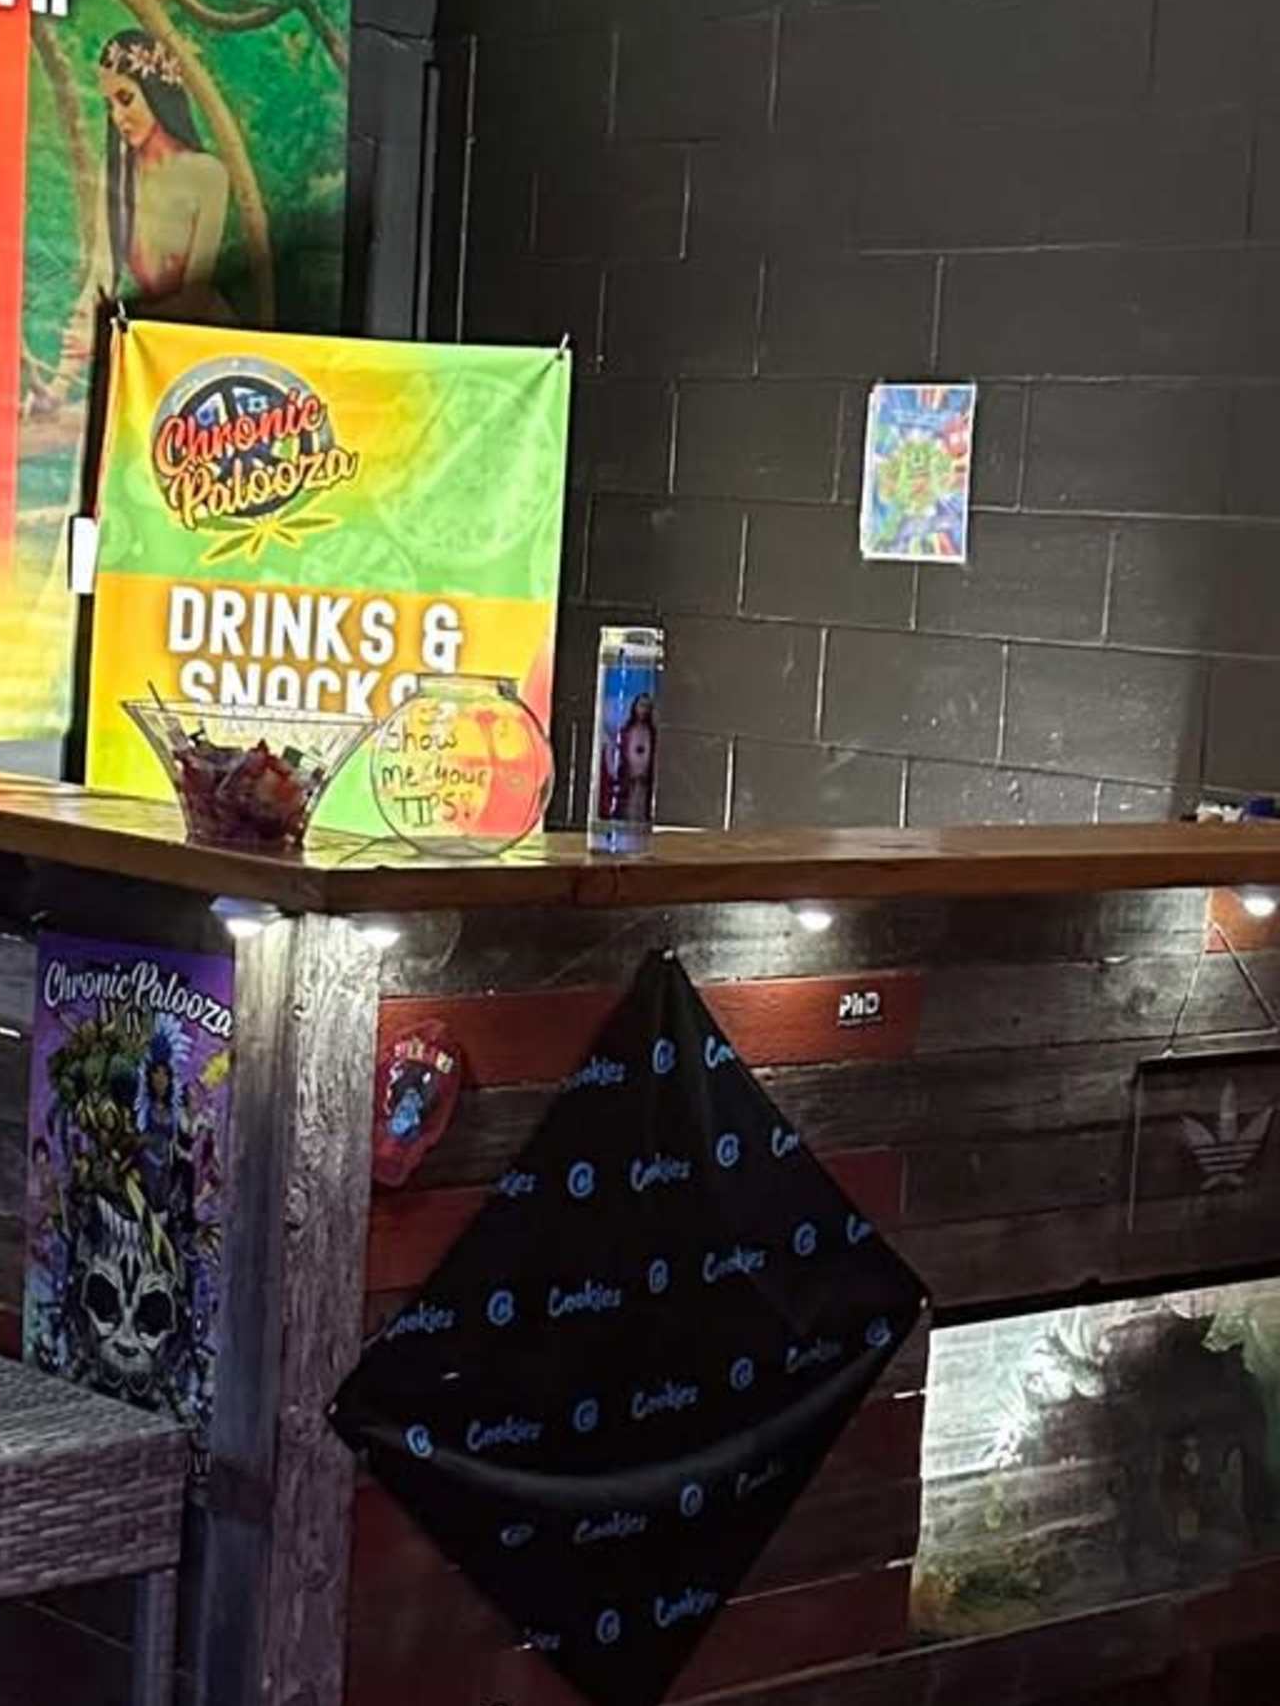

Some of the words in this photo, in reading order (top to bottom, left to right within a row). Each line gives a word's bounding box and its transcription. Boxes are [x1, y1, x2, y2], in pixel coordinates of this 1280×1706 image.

[153, 387, 327, 477] Chronic
[169, 448, 360, 530] Palooza
[168, 585, 397, 666] DRINKS
[421, 601, 464, 674] &
